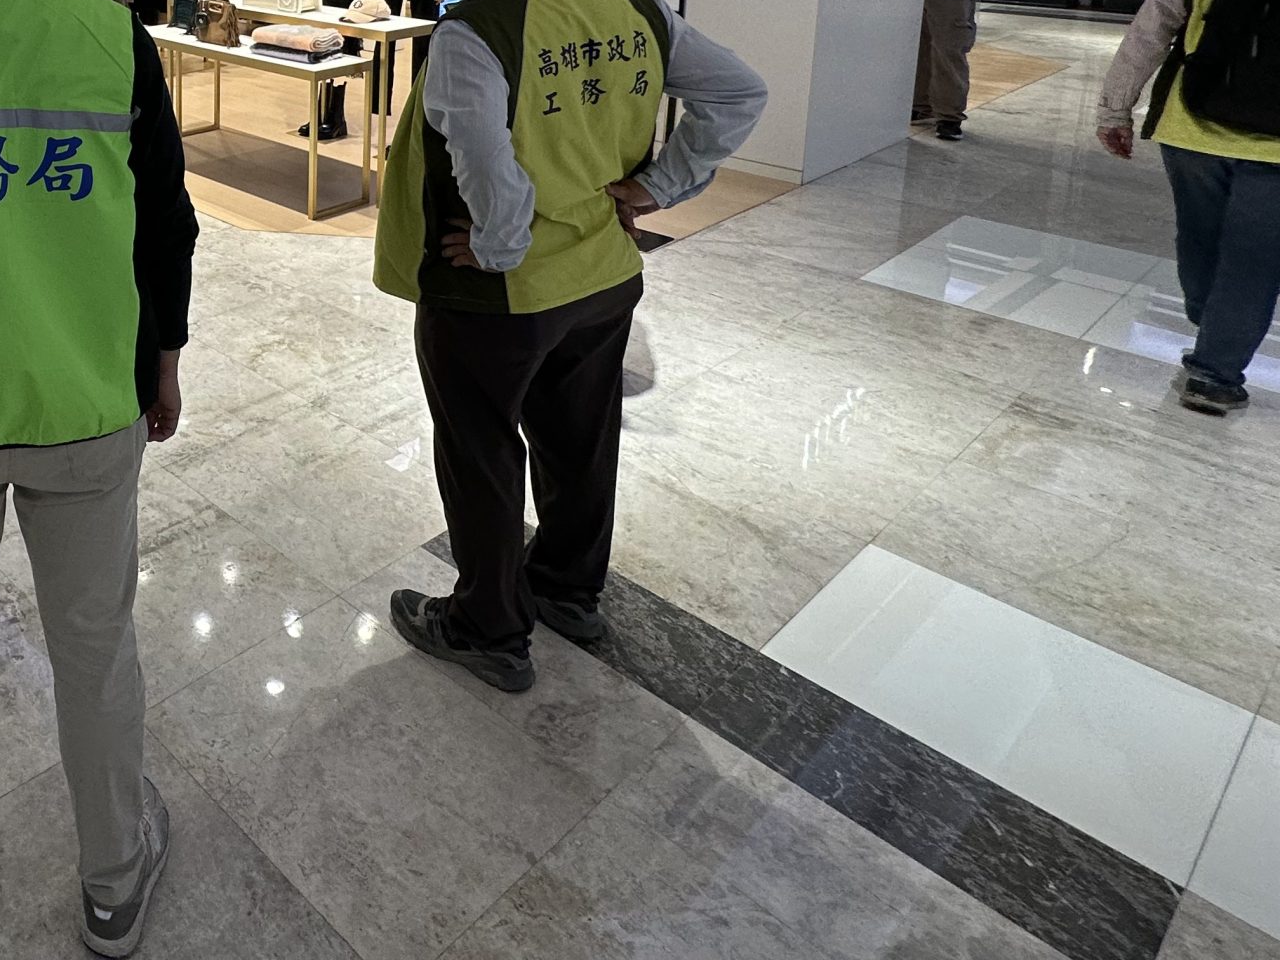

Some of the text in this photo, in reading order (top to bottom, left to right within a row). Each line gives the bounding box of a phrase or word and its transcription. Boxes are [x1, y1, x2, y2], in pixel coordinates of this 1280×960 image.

[538, 30, 648, 78] 高雄市政府
[542, 70, 649, 116] 工務局
